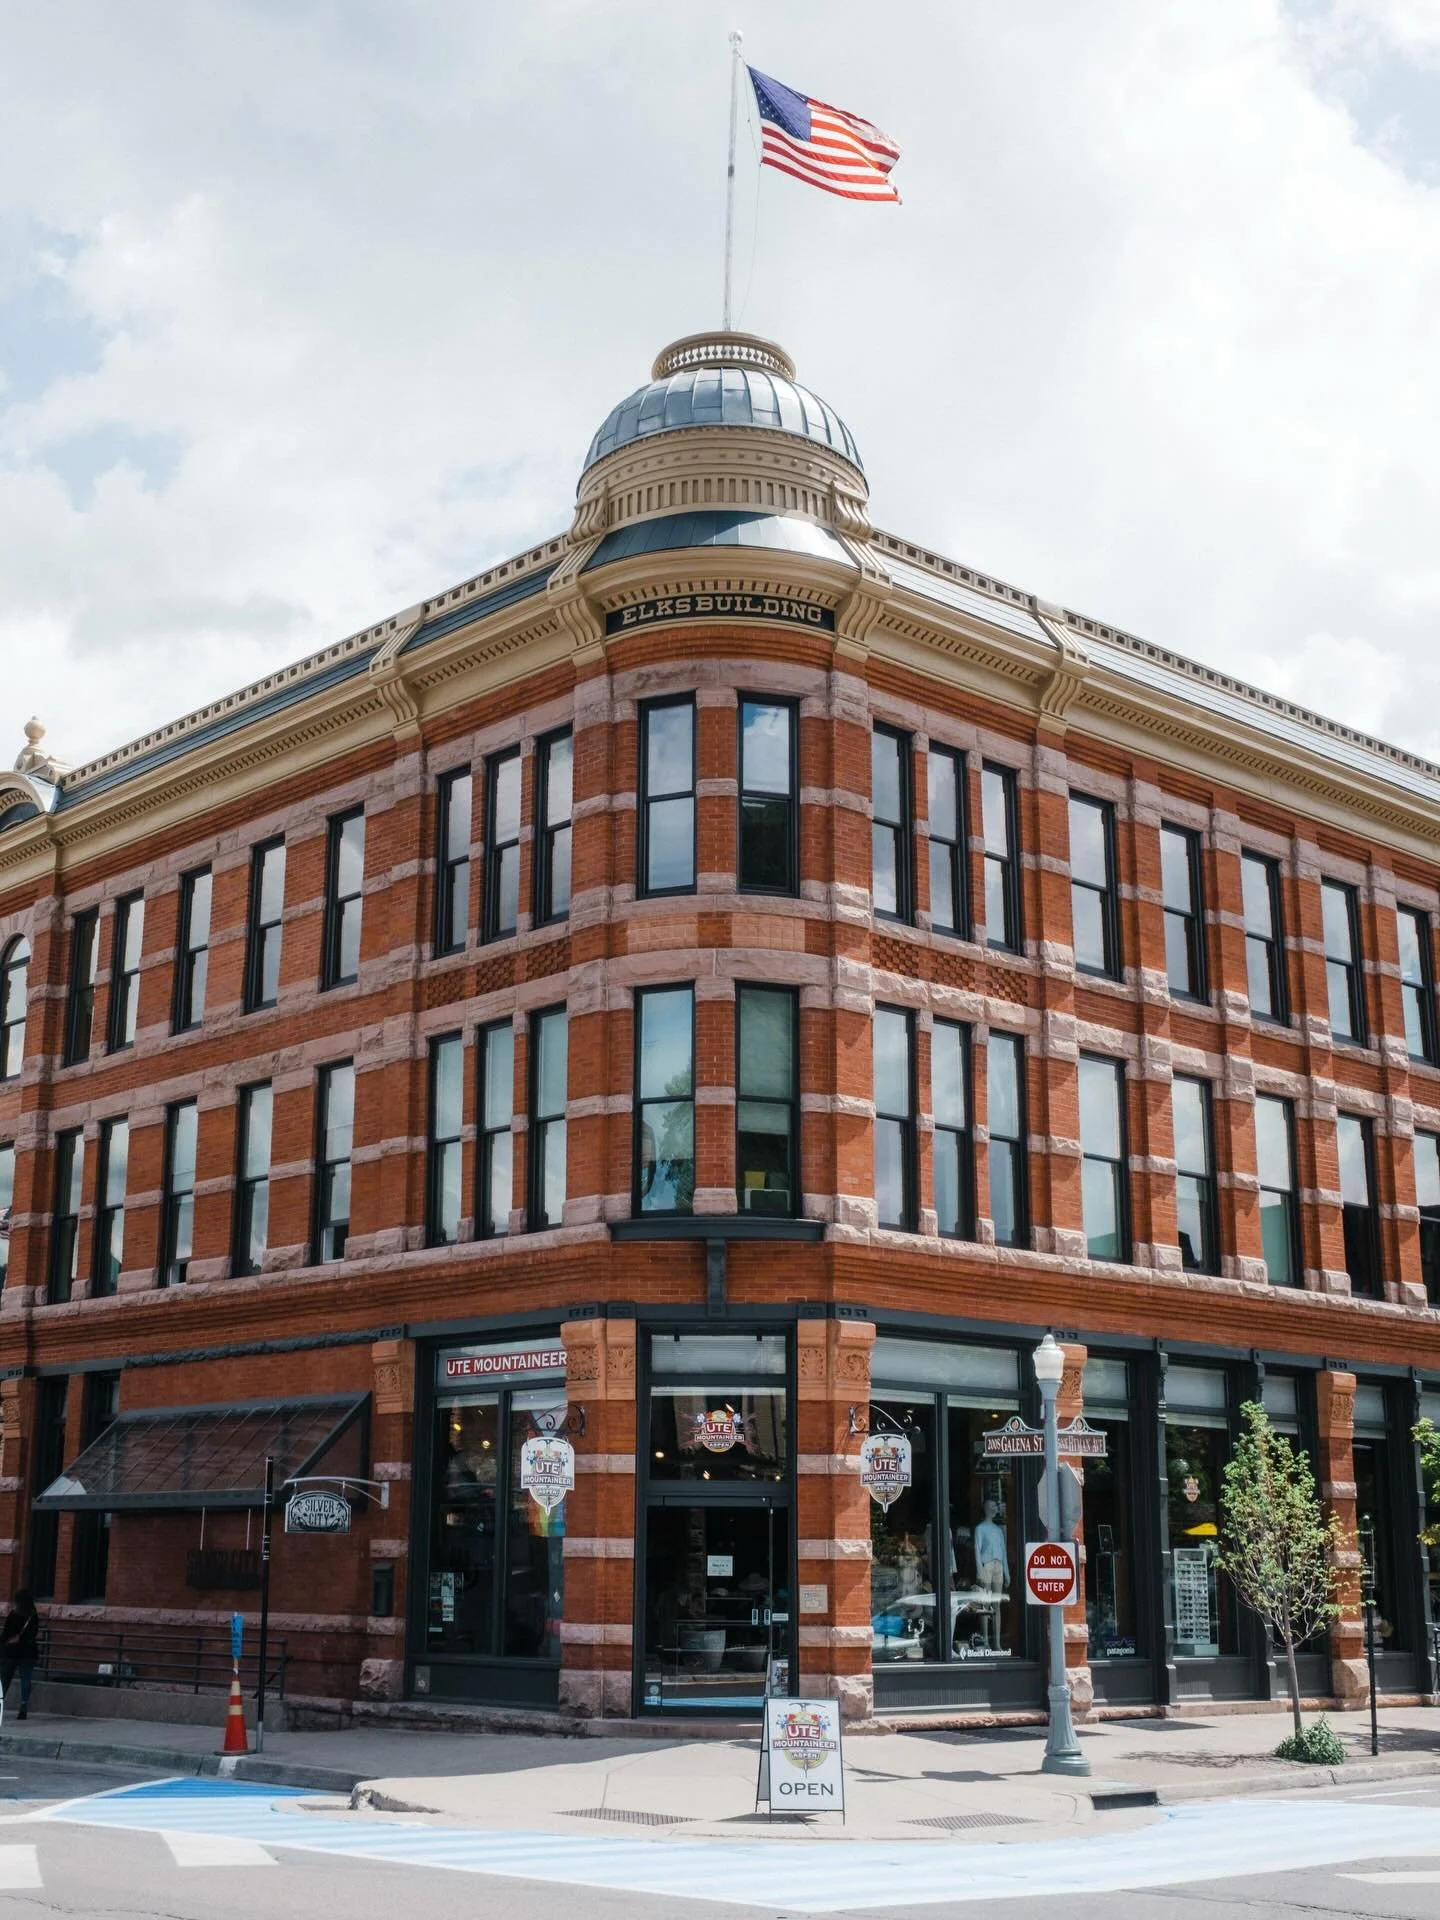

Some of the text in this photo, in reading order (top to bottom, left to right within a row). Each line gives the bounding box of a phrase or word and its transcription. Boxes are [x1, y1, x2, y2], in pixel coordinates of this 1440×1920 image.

[622, 596, 822, 625] ELKS BUILDING
[446, 1351, 568, 1375] UTE MOUNTAINEER
[706, 1422, 732, 1433] UTE
[1001, 1435, 1031, 1453] GALENA
[535, 1461, 560, 1474] UTE
[873, 1458, 897, 1471] UTE
[524, 1476, 571, 1485] MOUNTAINEER
[863, 1473, 909, 1481] MOUNTAINEER
[305, 1499, 334, 1512] SILVER
[309, 1513, 330, 1526] CITY
[1033, 1555, 1067, 1565] DO NOT
[1037, 1582, 1065, 1592] ENTER
[967, 1648, 1012, 1657] Black Diamond
[1106, 1647, 1135, 1656] patagonia
[787, 1724, 820, 1739] UTE
[773, 1739, 836, 1749] MOUNTAINEER
[779, 1782, 834, 1796] OPEN
